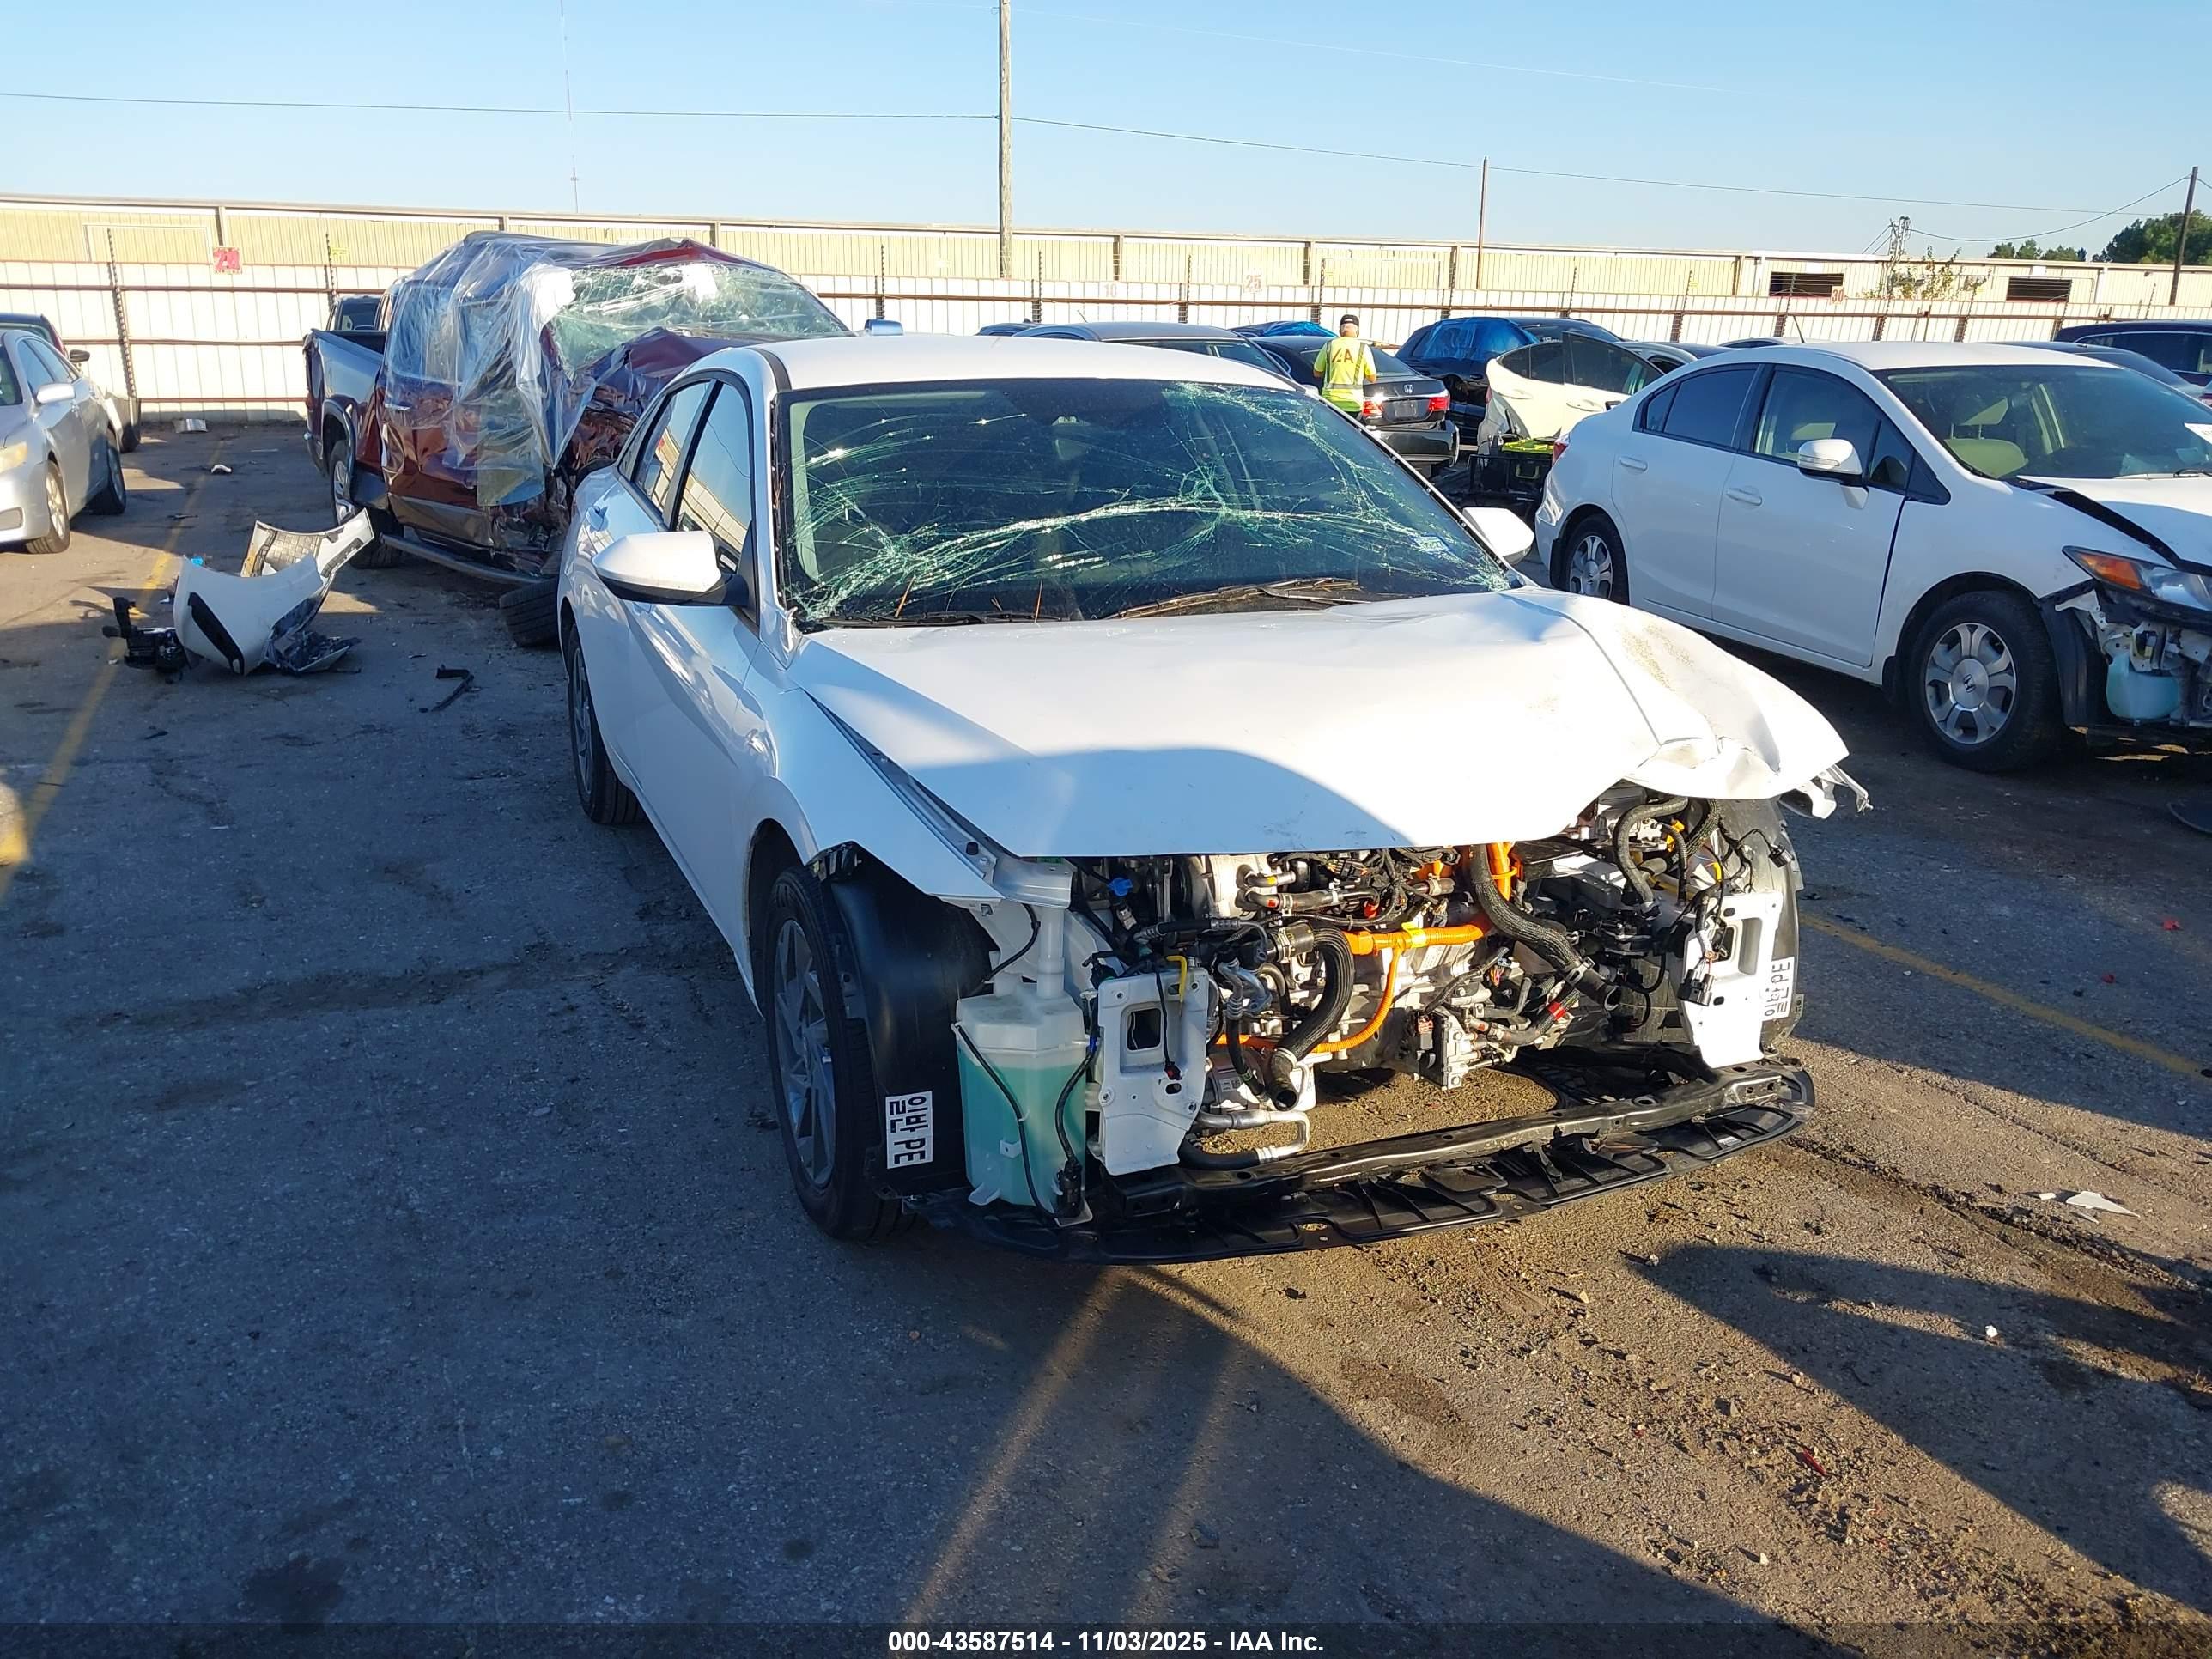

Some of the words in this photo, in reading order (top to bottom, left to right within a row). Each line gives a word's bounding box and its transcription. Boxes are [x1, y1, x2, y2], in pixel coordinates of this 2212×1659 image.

[1245, 274, 1262, 289] 25
[1831, 289, 1844, 302] 30
[1771, 962, 1791, 984] PE
[889, 1096, 929, 1133] 일반
[894, 1137, 926, 1164] PE
